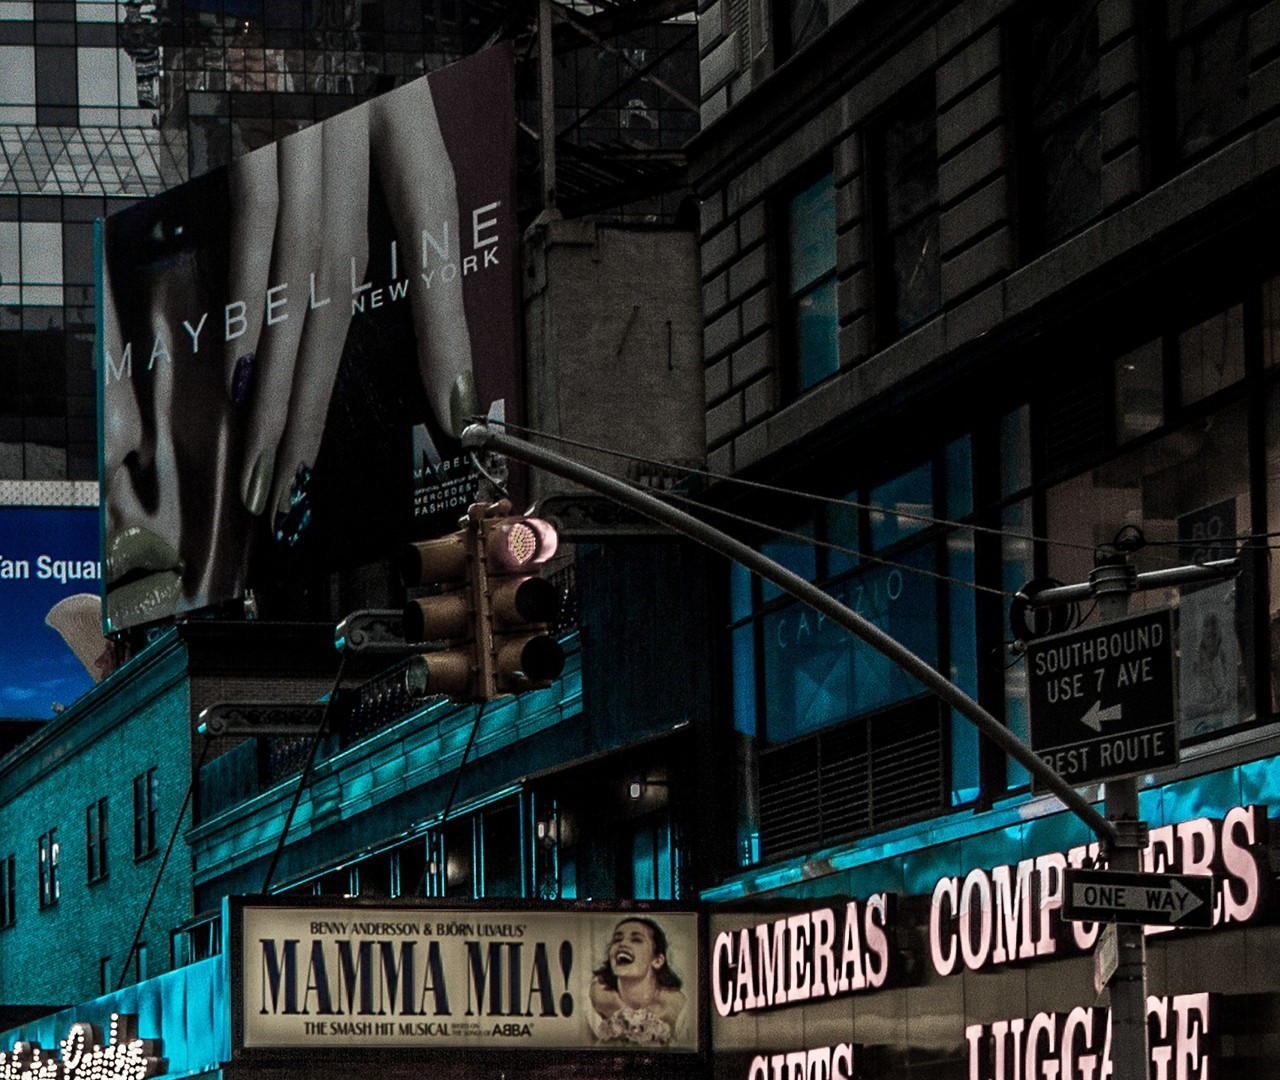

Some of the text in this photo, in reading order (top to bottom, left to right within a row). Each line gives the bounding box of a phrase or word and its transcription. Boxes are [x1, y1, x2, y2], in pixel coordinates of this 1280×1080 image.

[104, 201, 500, 384] MAYBELLINE
[351, 246, 499, 316] NEW YORK
[413, 457, 470, 479] MAYBEL
[414, 496, 467, 516] FASHION
[1035, 624, 1163, 676] SOUTHBOUND
[1046, 657, 1152, 703] USE 7 AVE
[1100, 731, 1165, 768] ROUTE
[1084, 886, 1191, 911] ONE WAY
[311, 922, 348, 937] BENNY
[349, 922, 420, 937] ANDERSSON
[424, 922, 433, 936] &
[436, 920, 474, 937] BJÖRN
[712, 893, 889, 1017] CAMERAS
[260, 939, 576, 1018] MAMMA MIA!
[305, 1022, 450, 1037] THE SMASH HIT MUSICAL
